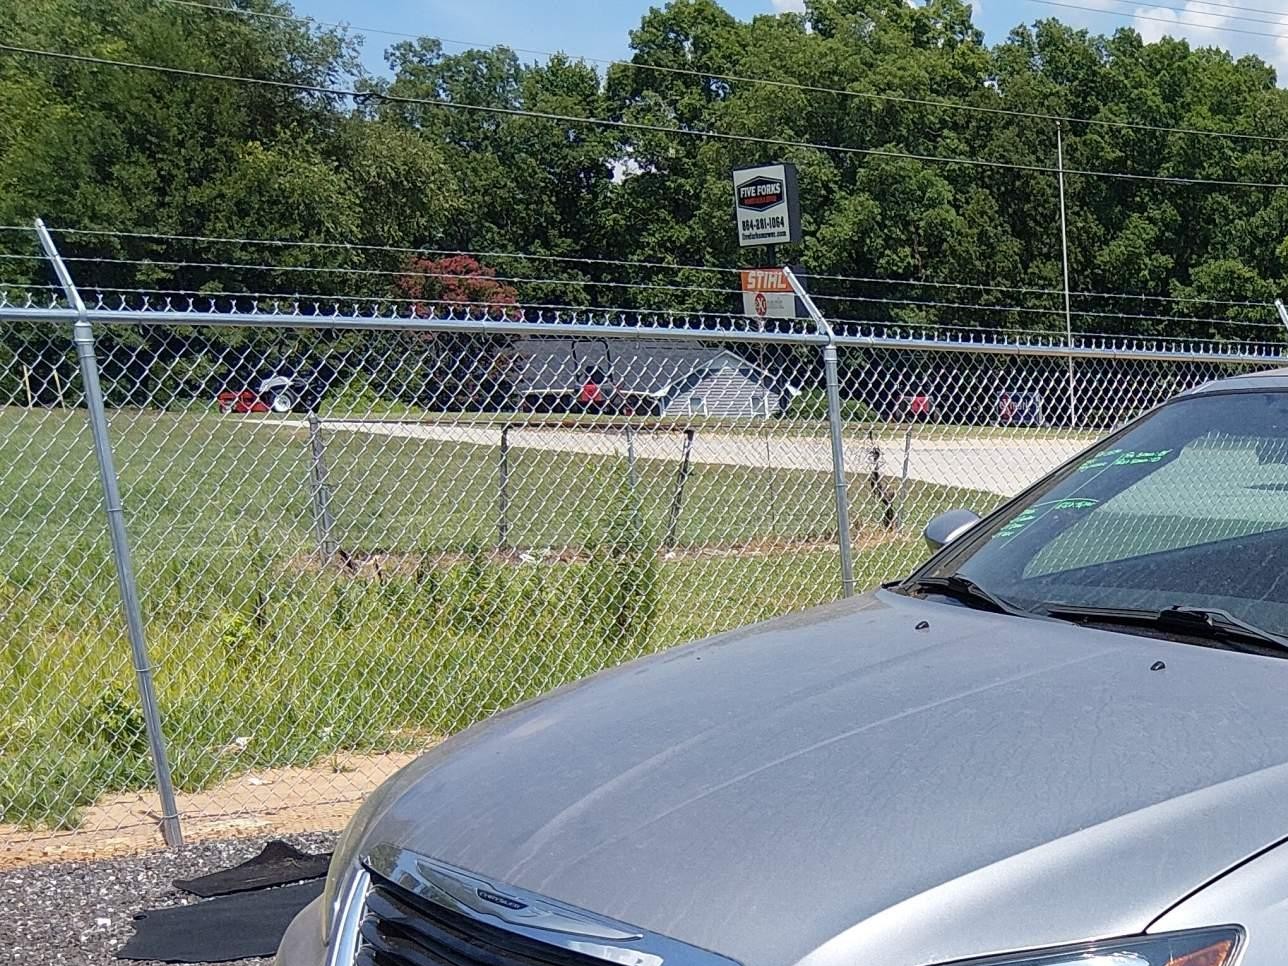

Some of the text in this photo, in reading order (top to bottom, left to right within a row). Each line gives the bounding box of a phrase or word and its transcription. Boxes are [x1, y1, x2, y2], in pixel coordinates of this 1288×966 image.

[740, 183, 781, 198] FIVE FORKS
[747, 271, 787, 289] STIHL
